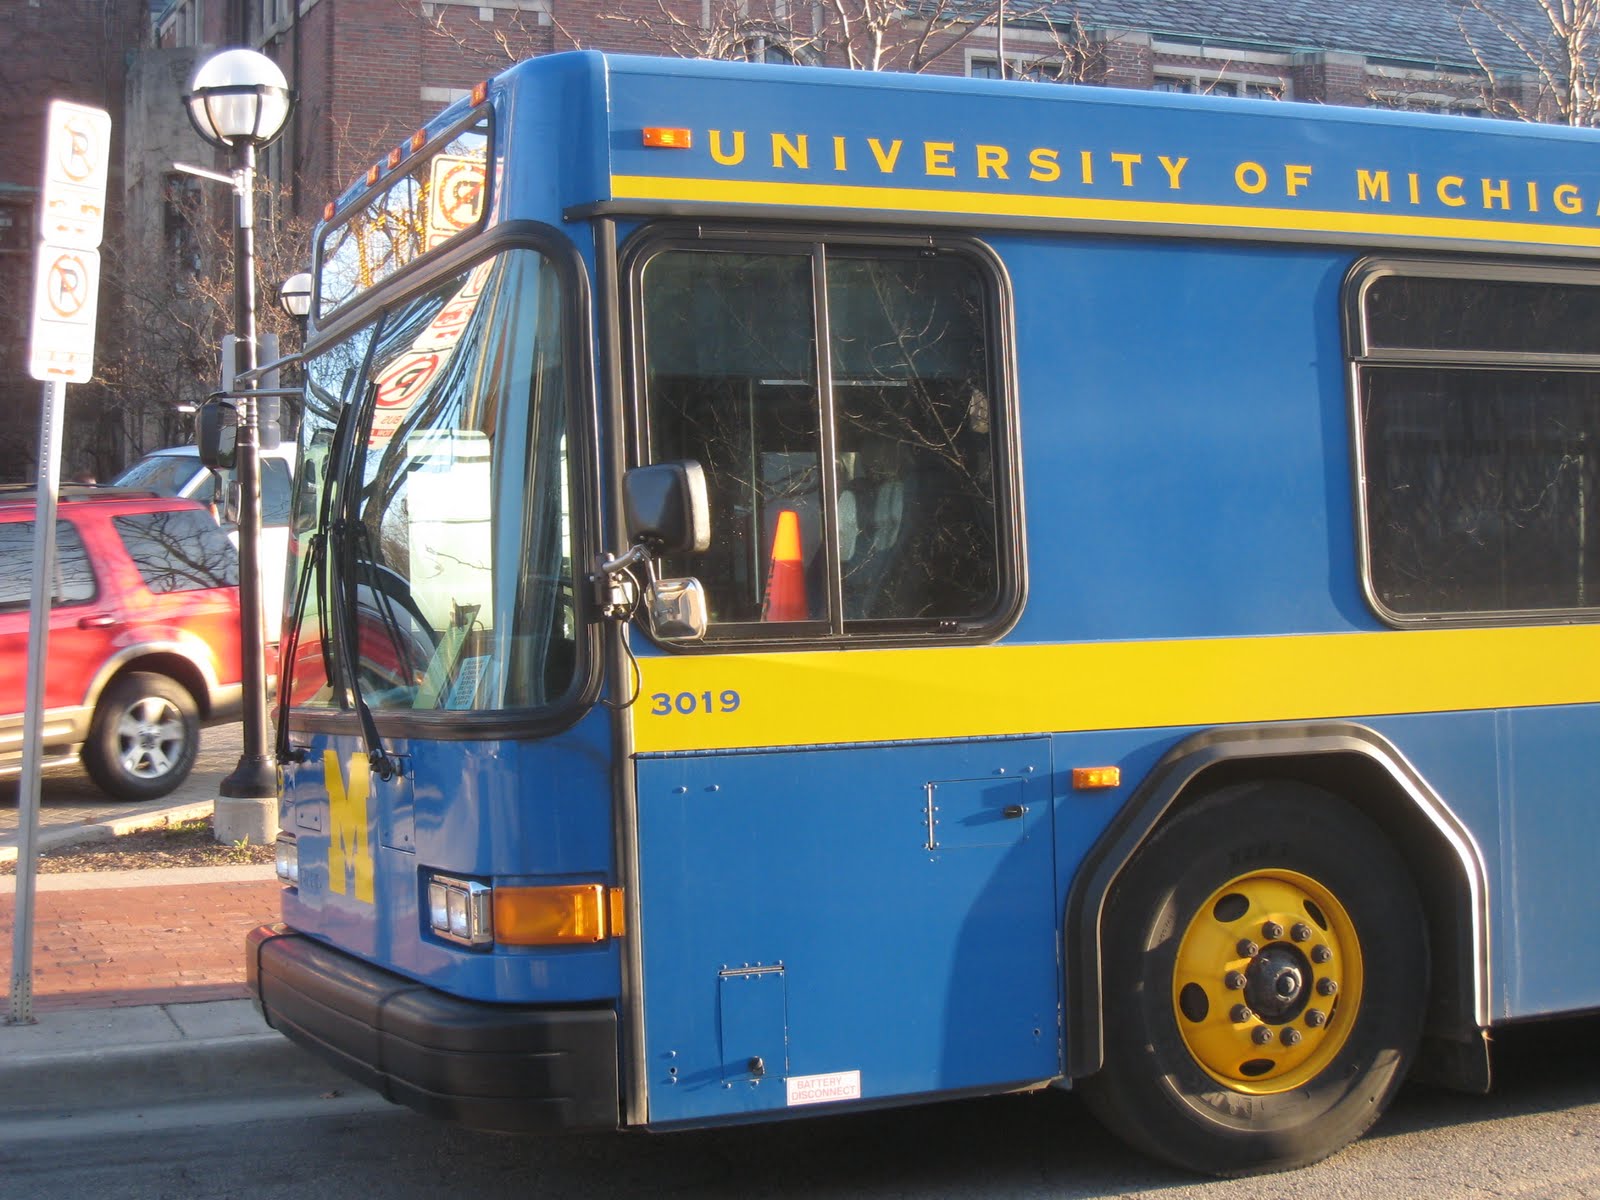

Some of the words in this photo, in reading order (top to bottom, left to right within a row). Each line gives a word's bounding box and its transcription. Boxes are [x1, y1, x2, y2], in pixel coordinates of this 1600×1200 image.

[708, 129, 1189, 190] UNIVERSITY
[1234, 161, 1313, 196] OF
[1356, 169, 1600, 217] MICHIG
[650, 690, 741, 716] 3019
[791, 1085, 856, 1101] DISCONNECT
[797, 1077, 842, 1090] BATTERY
